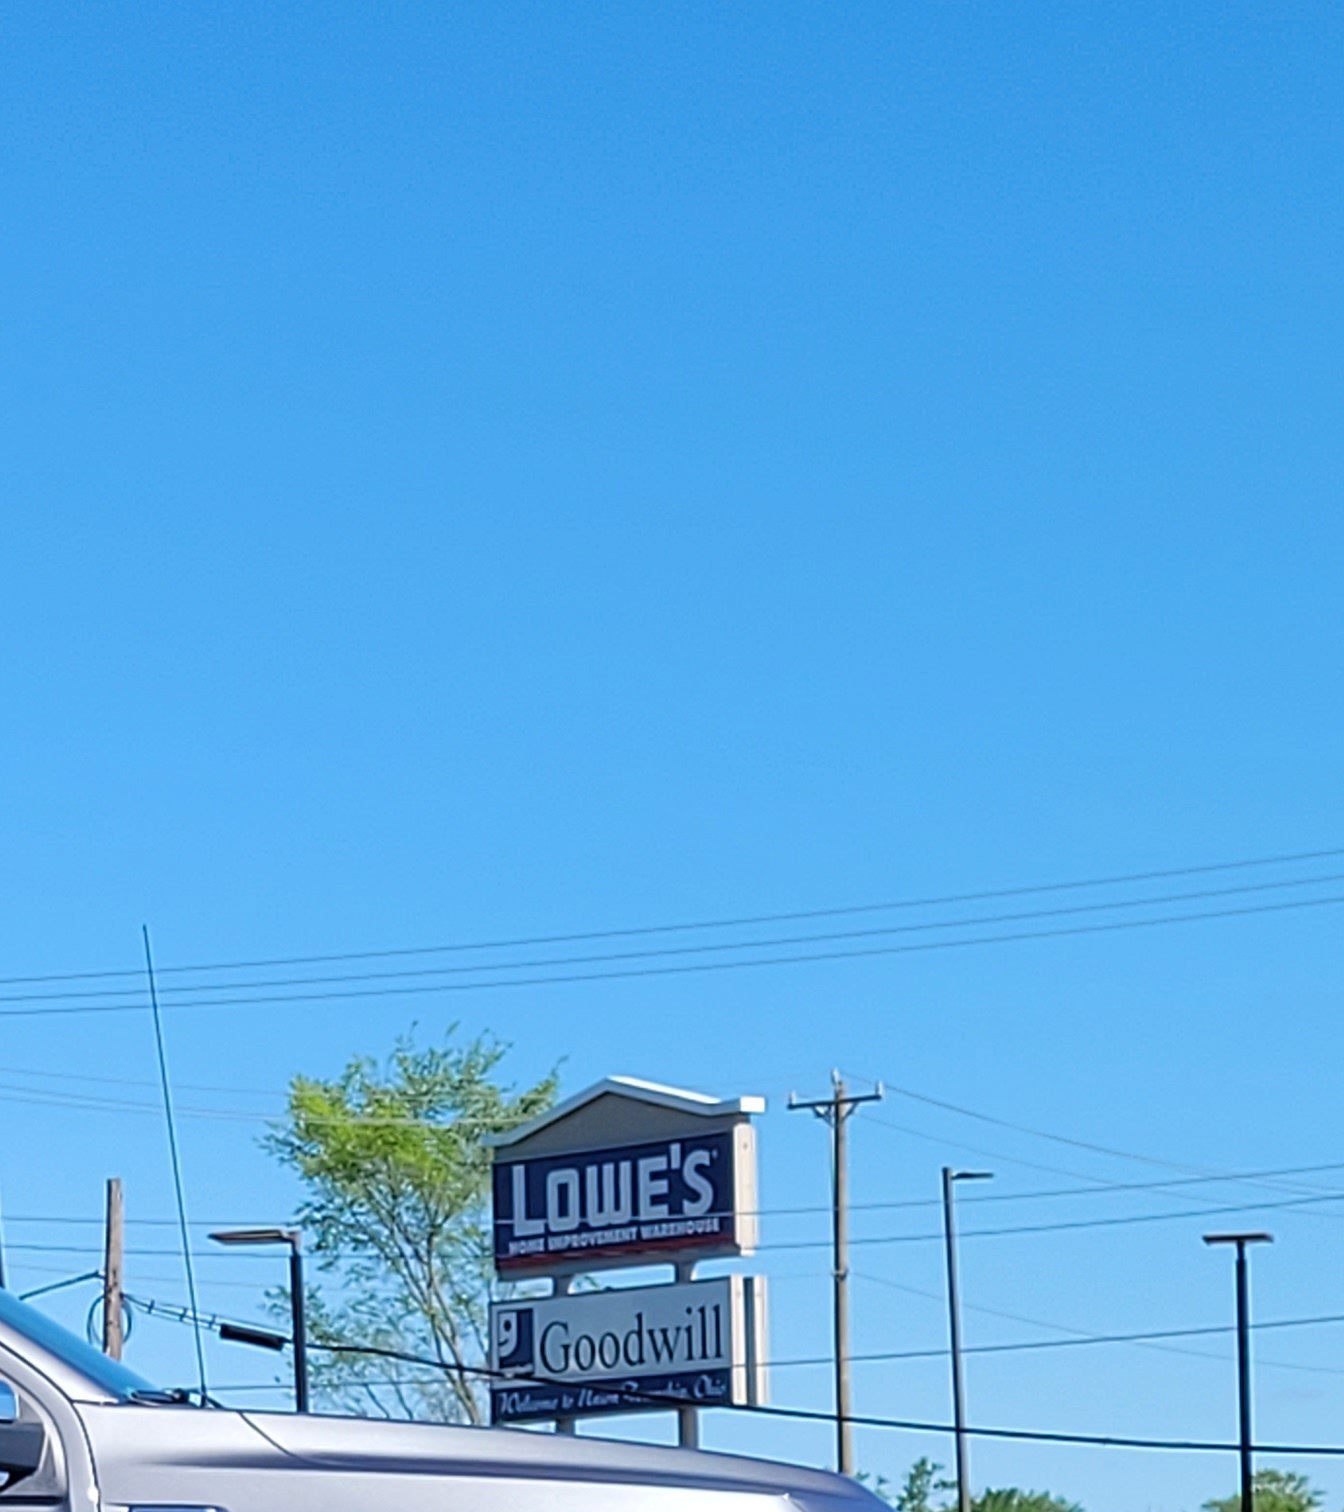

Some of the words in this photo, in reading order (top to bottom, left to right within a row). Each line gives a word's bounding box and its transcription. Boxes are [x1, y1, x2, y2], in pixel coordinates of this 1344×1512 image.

[511, 1143, 714, 1237] LOWE'S
[548, 1227, 637, 1252] IMPROVEMENT
[640, 1218, 720, 1240] WAREHOUSE
[540, 1304, 723, 1373] Goodwill
